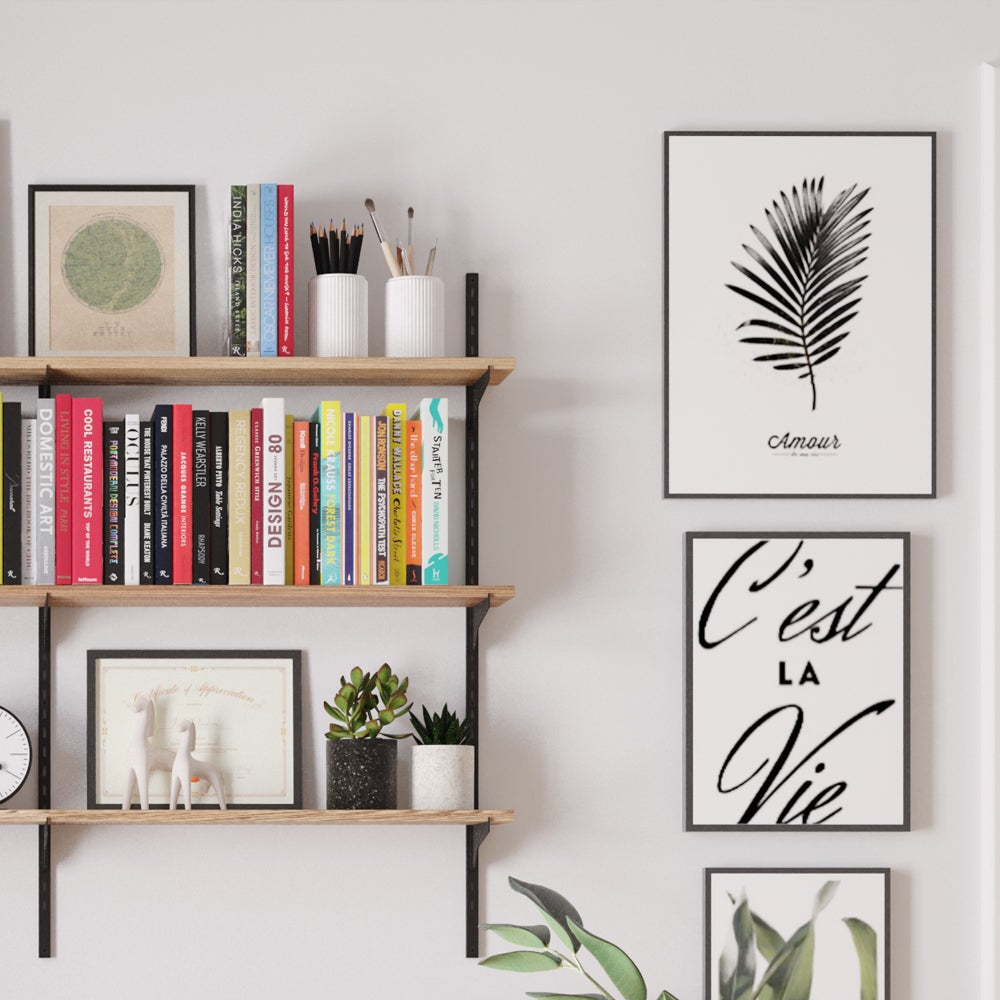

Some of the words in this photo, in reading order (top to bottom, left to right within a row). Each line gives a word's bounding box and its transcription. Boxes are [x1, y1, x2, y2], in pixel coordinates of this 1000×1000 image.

[232, 196, 242, 233] INDIA
[264, 200, 274, 244] HOUSES
[232, 234, 242, 274] HICKS
[264, 246, 274, 300] NIEMEYER
[264, 301, 274, 342] OSCAR
[60, 411, 69, 451] LIVING
[84, 409, 92, 437] COOL
[195, 417, 206, 439] KELLY
[326, 408, 335, 450] NICOLE
[377, 420, 386, 437] JON
[393, 409, 402, 443] DANNY
[410, 434, 418, 448] the
[768, 432, 842, 449] Amour
[40, 408, 53, 498] DOMESTIC
[60, 453, 69, 465] IN
[235, 420, 246, 478] REGENCY
[268, 434, 282, 453] 80
[377, 438, 386, 470] RONSON
[431, 435, 443, 473] STARTER
[84, 441, 92, 518] RESTAURANTS
[126, 428, 139, 508] OCULUS
[195, 440, 206, 487] WEARSTLER
[326, 451, 335, 491] KRAUSS
[393, 447, 402, 495] WALLACE
[60, 468, 69, 503] STYLE
[235, 482, 246, 524] REDUX
[377, 478, 386, 491] THE
[410, 474, 418, 498] hand
[432, 480, 442, 499] TEN
[40, 504, 53, 535] ART
[110, 494, 118, 522] DESIGN
[213, 505, 222, 528] Settings
[268, 482, 282, 548] DESIGN
[326, 493, 335, 532] FOREST
[377, 493, 386, 538] PSYCHOPATH
[392, 498, 403, 536] Charlotte
[110, 524, 118, 564] COMPLETE
[326, 535, 335, 564] DARK
[377, 540, 386, 557] TEST
[698, 540, 902, 649] C'est
[778, 661, 820, 685] LA
[718, 700, 896, 824] Vie
